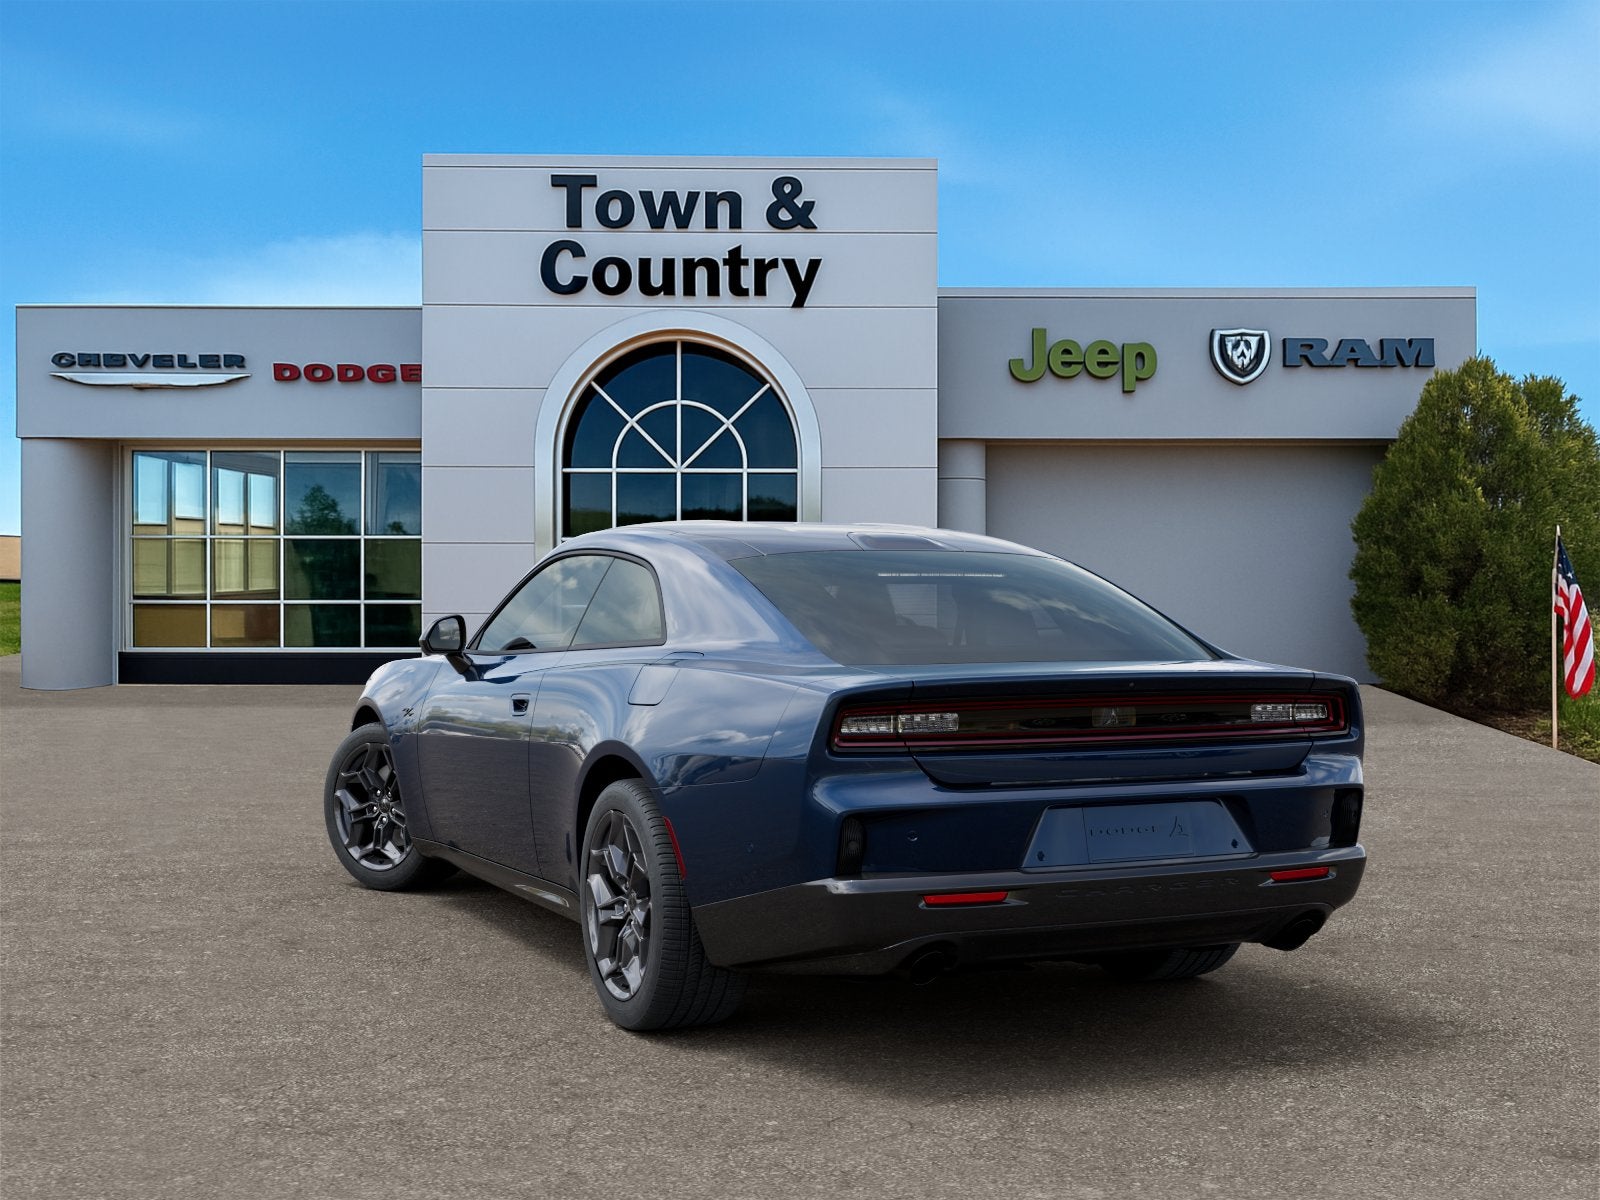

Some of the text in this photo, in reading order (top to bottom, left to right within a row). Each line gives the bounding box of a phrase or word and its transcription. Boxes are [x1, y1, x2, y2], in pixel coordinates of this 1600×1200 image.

[550, 174, 817, 230] Town &
[540, 239, 822, 308] Country
[273, 363, 421, 382] DODGE
[1008, 327, 1157, 392] Jeep
[1283, 338, 1434, 367] RAM
